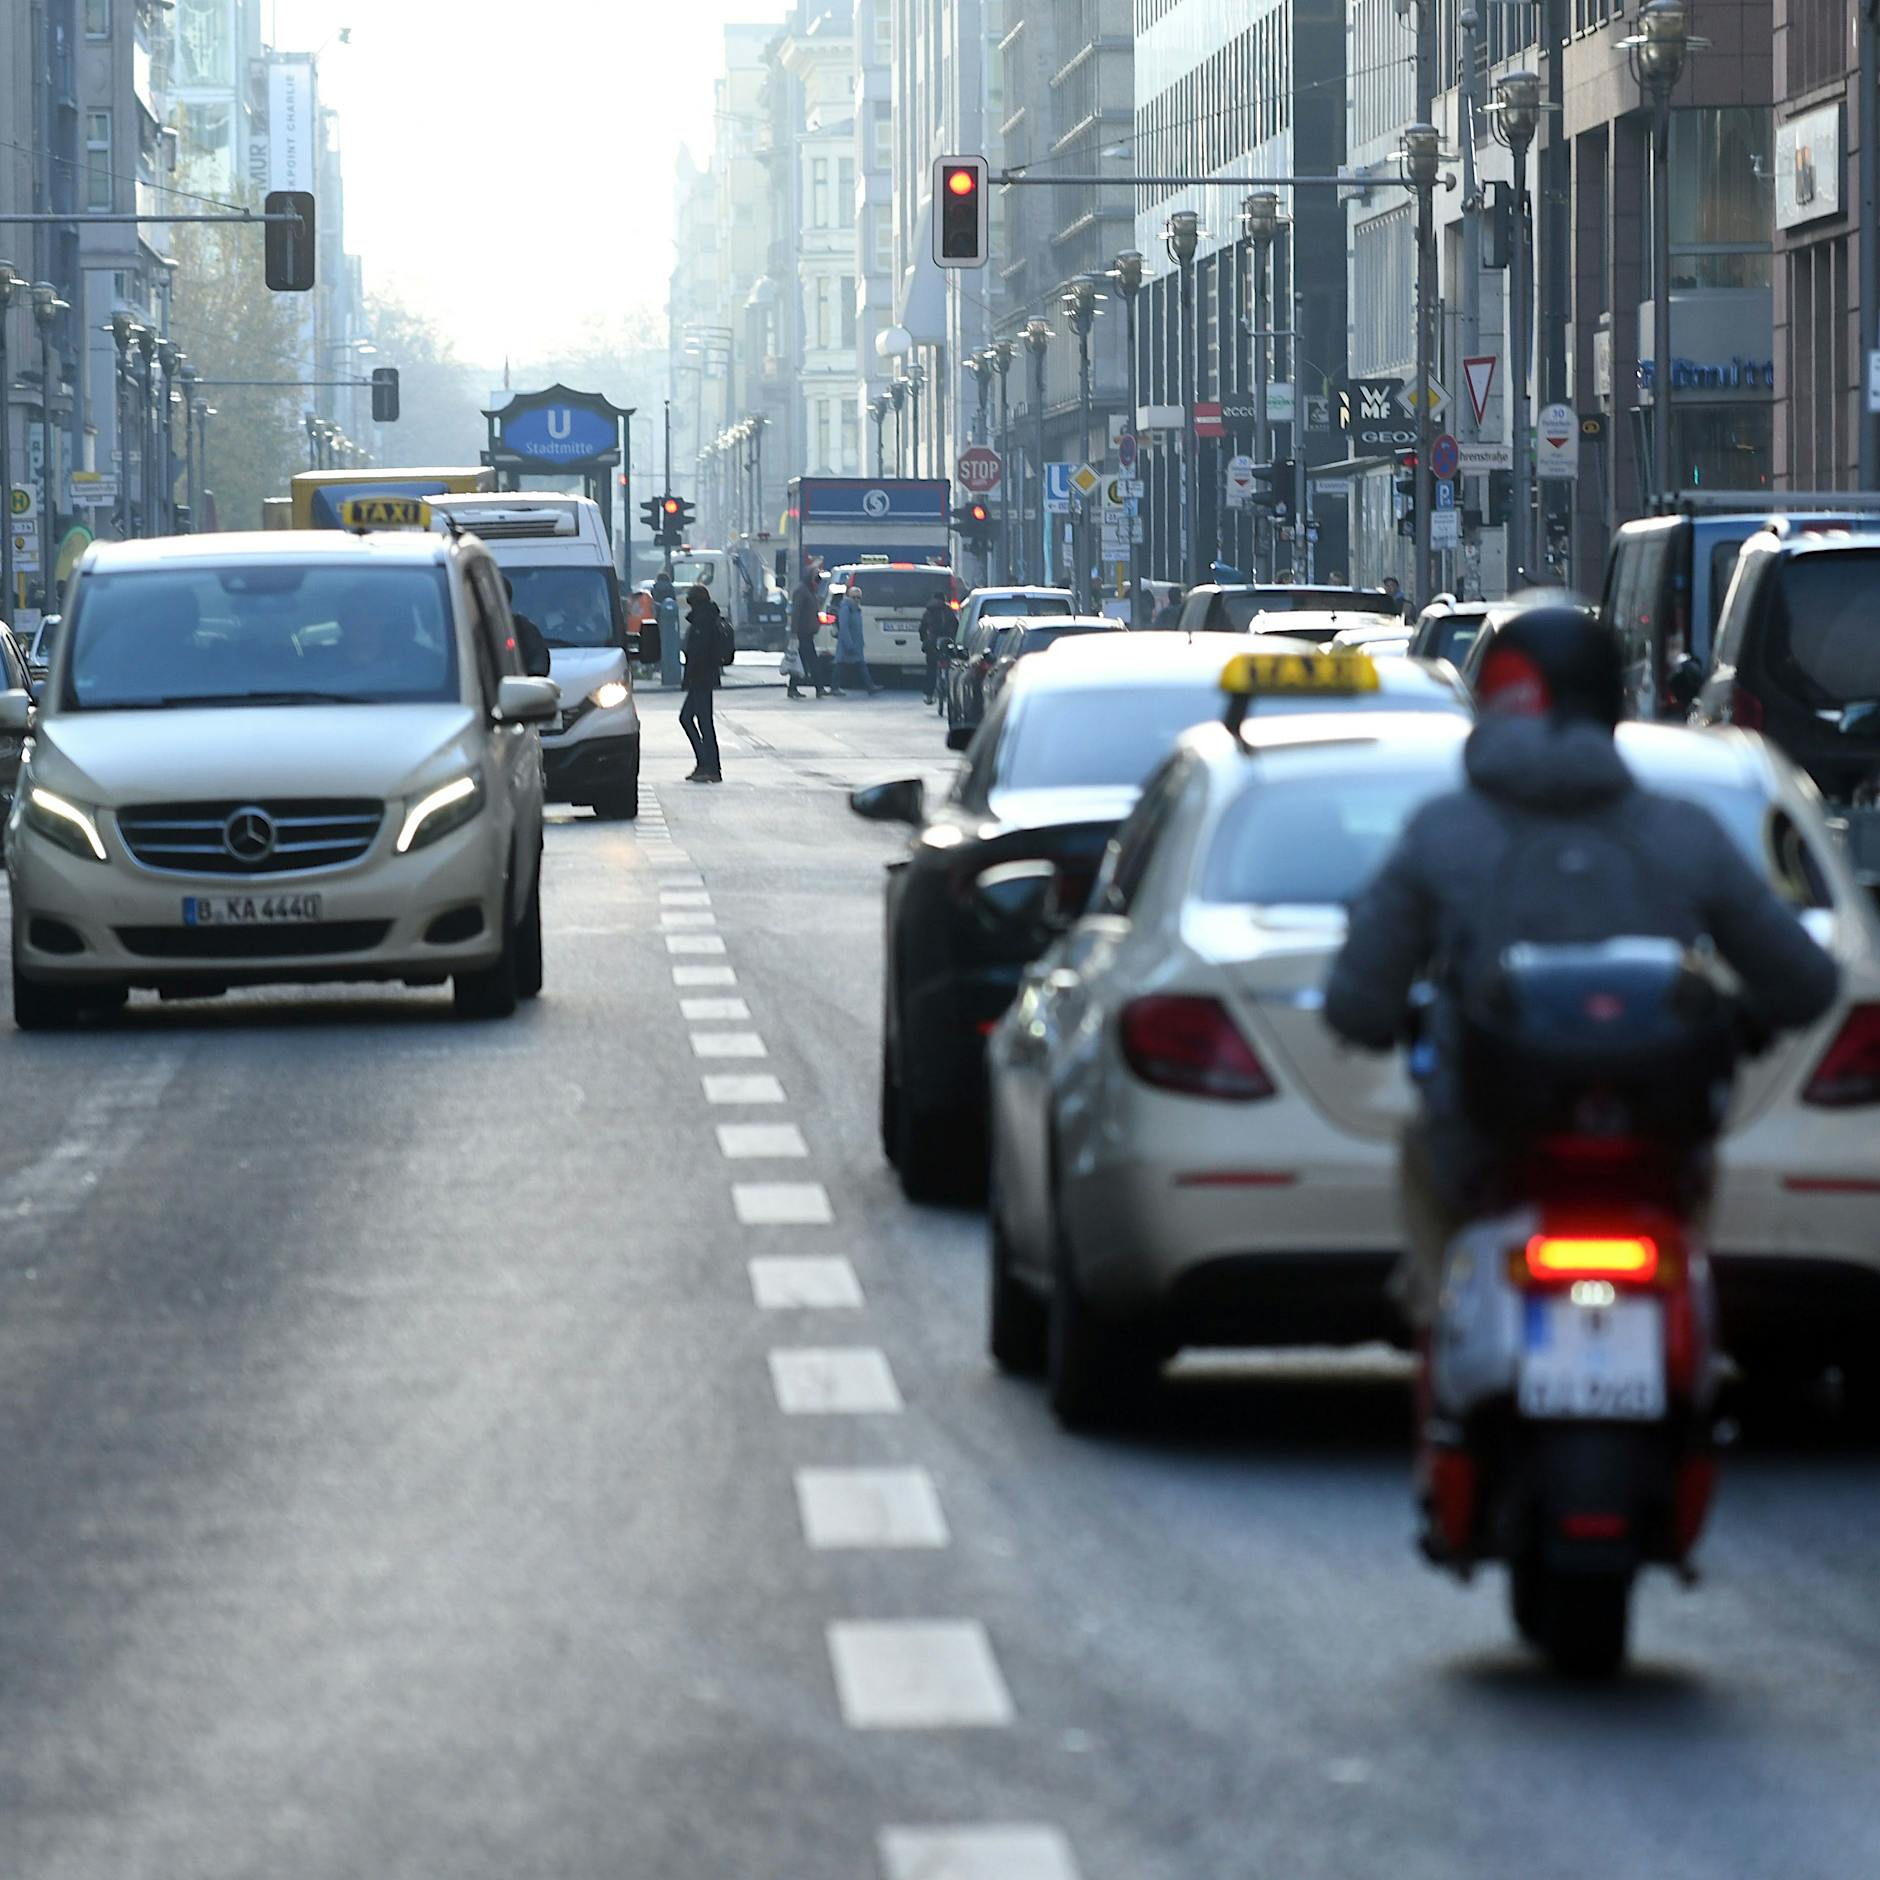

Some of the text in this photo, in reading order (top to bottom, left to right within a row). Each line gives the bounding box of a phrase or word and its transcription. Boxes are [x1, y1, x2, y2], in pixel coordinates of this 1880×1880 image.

[285, 74, 296, 188] KPOINT CHARLIE
[547, 409, 571, 439] U
[525, 441, 594, 455] Stadtmitte
[1459, 450, 1509, 464] hrenstraße
[960, 460, 999, 480] STOP
[355, 501, 419, 522] TAXI
[1251, 655, 1358, 691] TAXI
[199, 895, 317, 920] B KA 4440
